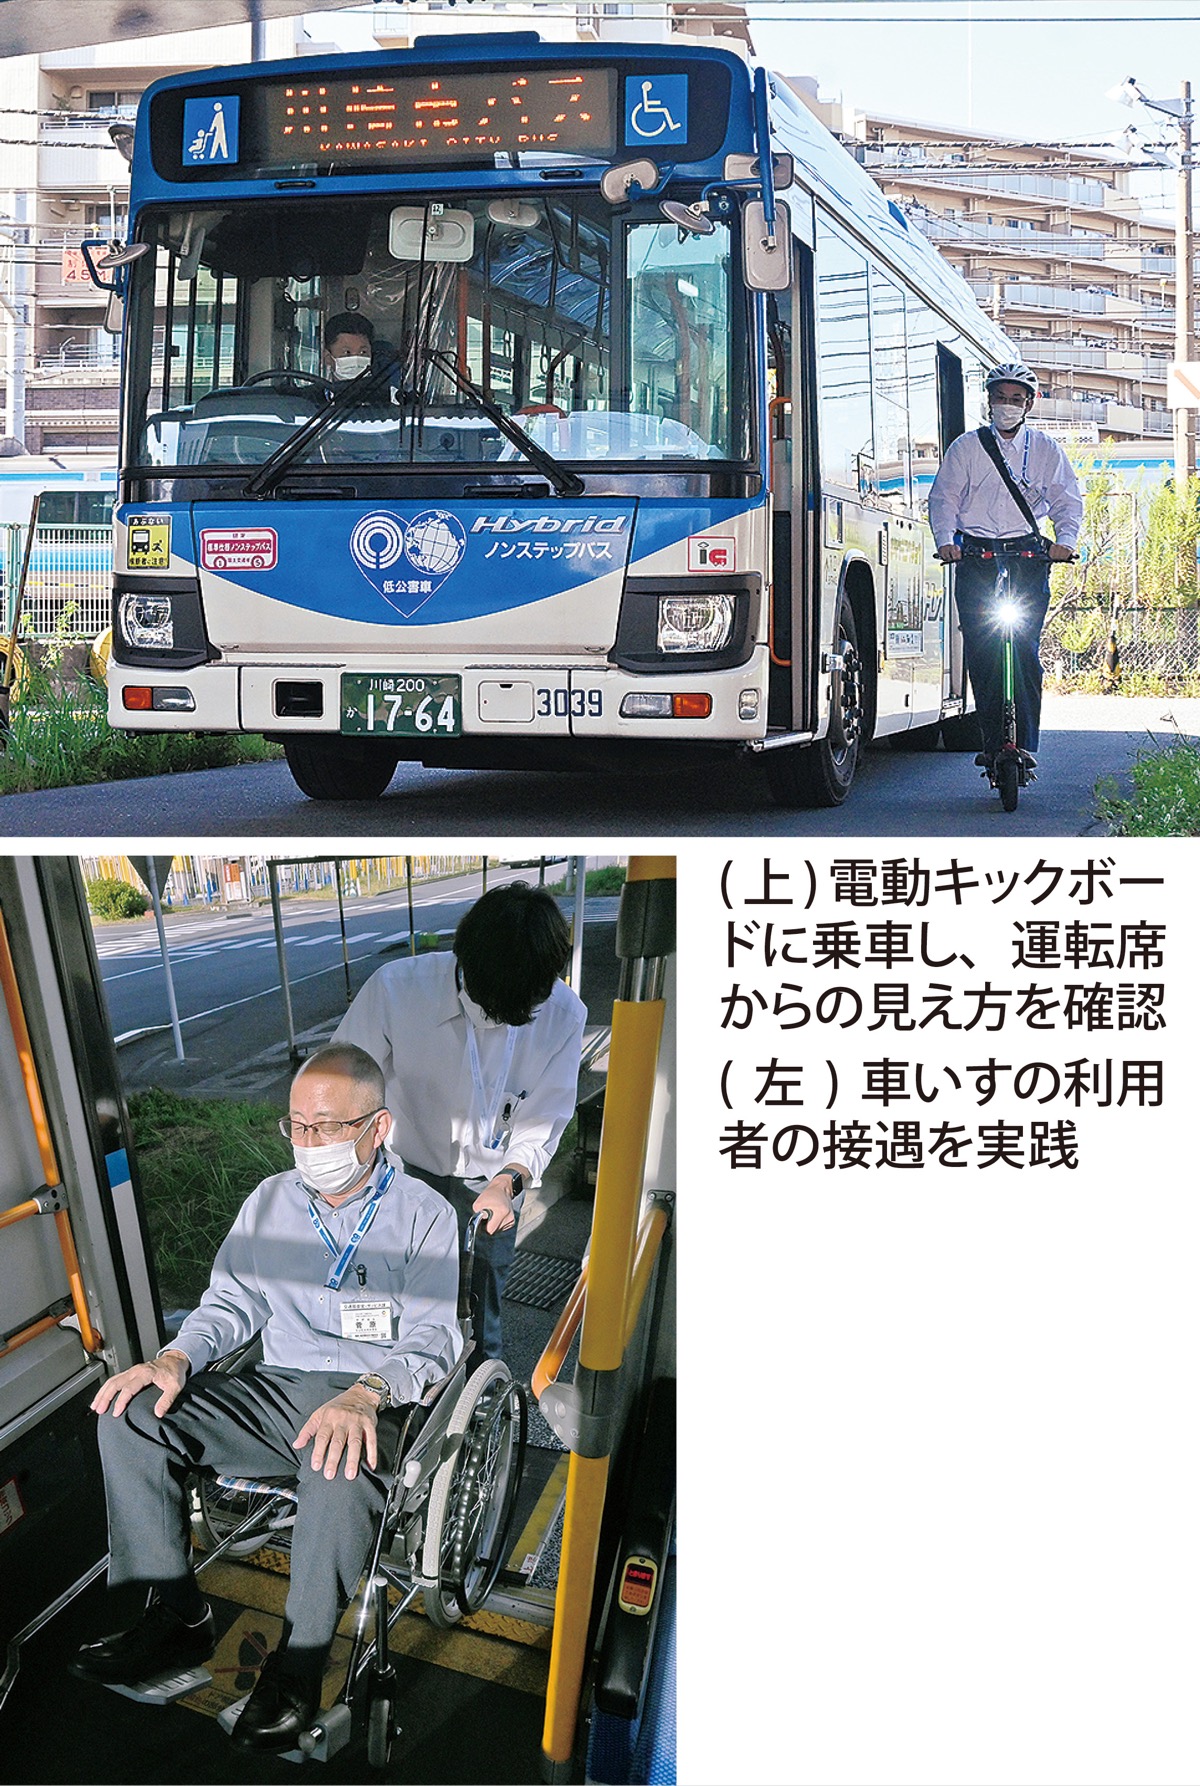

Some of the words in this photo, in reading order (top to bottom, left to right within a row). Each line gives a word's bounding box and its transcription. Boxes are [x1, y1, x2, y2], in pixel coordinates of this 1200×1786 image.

[470, 515, 628, 535] Hybrid
[484, 541, 613, 560] ノンステップバス
[383, 580, 432, 594] 低公害車
[537, 688, 603, 717] 3039
[346, 706, 358, 719] か
[367, 694, 455, 732] 17-64
